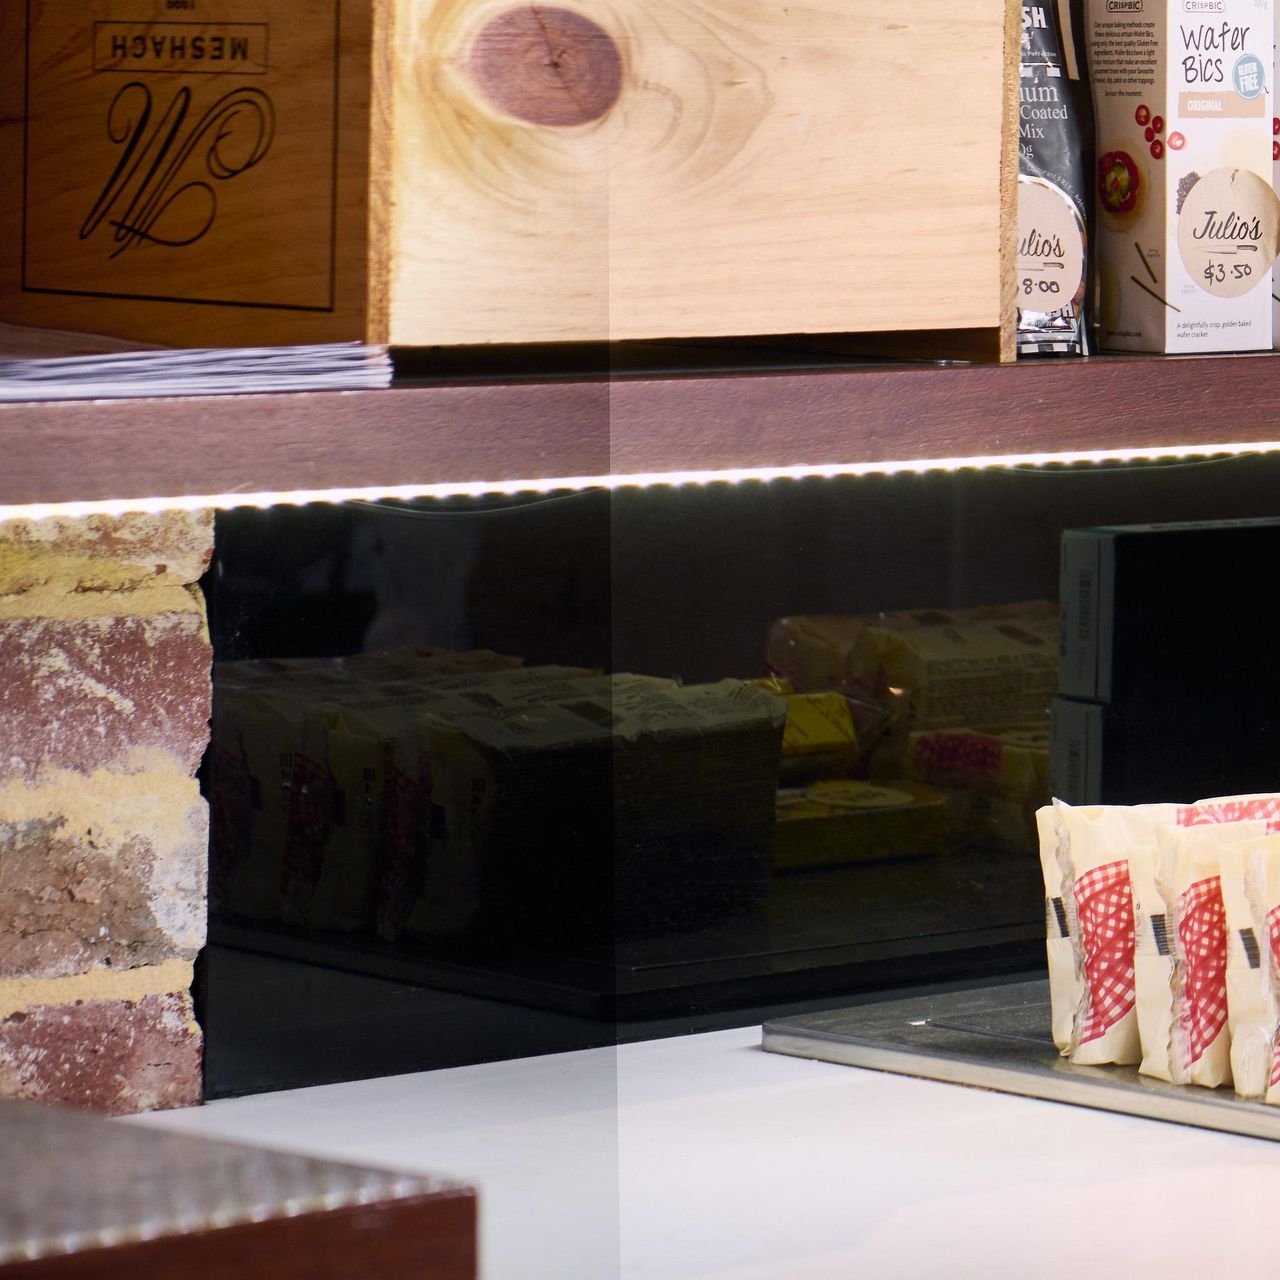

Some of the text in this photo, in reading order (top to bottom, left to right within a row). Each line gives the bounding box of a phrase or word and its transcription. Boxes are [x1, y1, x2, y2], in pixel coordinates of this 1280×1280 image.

[1108, 0, 1141, 11] CRISPBIC
[1185, 1, 1223, 11] CRISPBIC
[110, 34, 250, 61] MESHACH
[1179, 21, 1251, 53] Wafer
[1181, 53, 1225, 84] Bics
[1239, 73, 1260, 94] FREE
[1020, 104, 1069, 120] Coated
[1187, 99, 1223, 112] ORIGINAL
[1018, 125, 1046, 139] Mix
[1192, 210, 1264, 242] Julio's
[1017, 228, 1066, 259] ulio's
[1203, 259, 1253, 286] $3.50
[1182, 320, 1209, 331] delightfully
